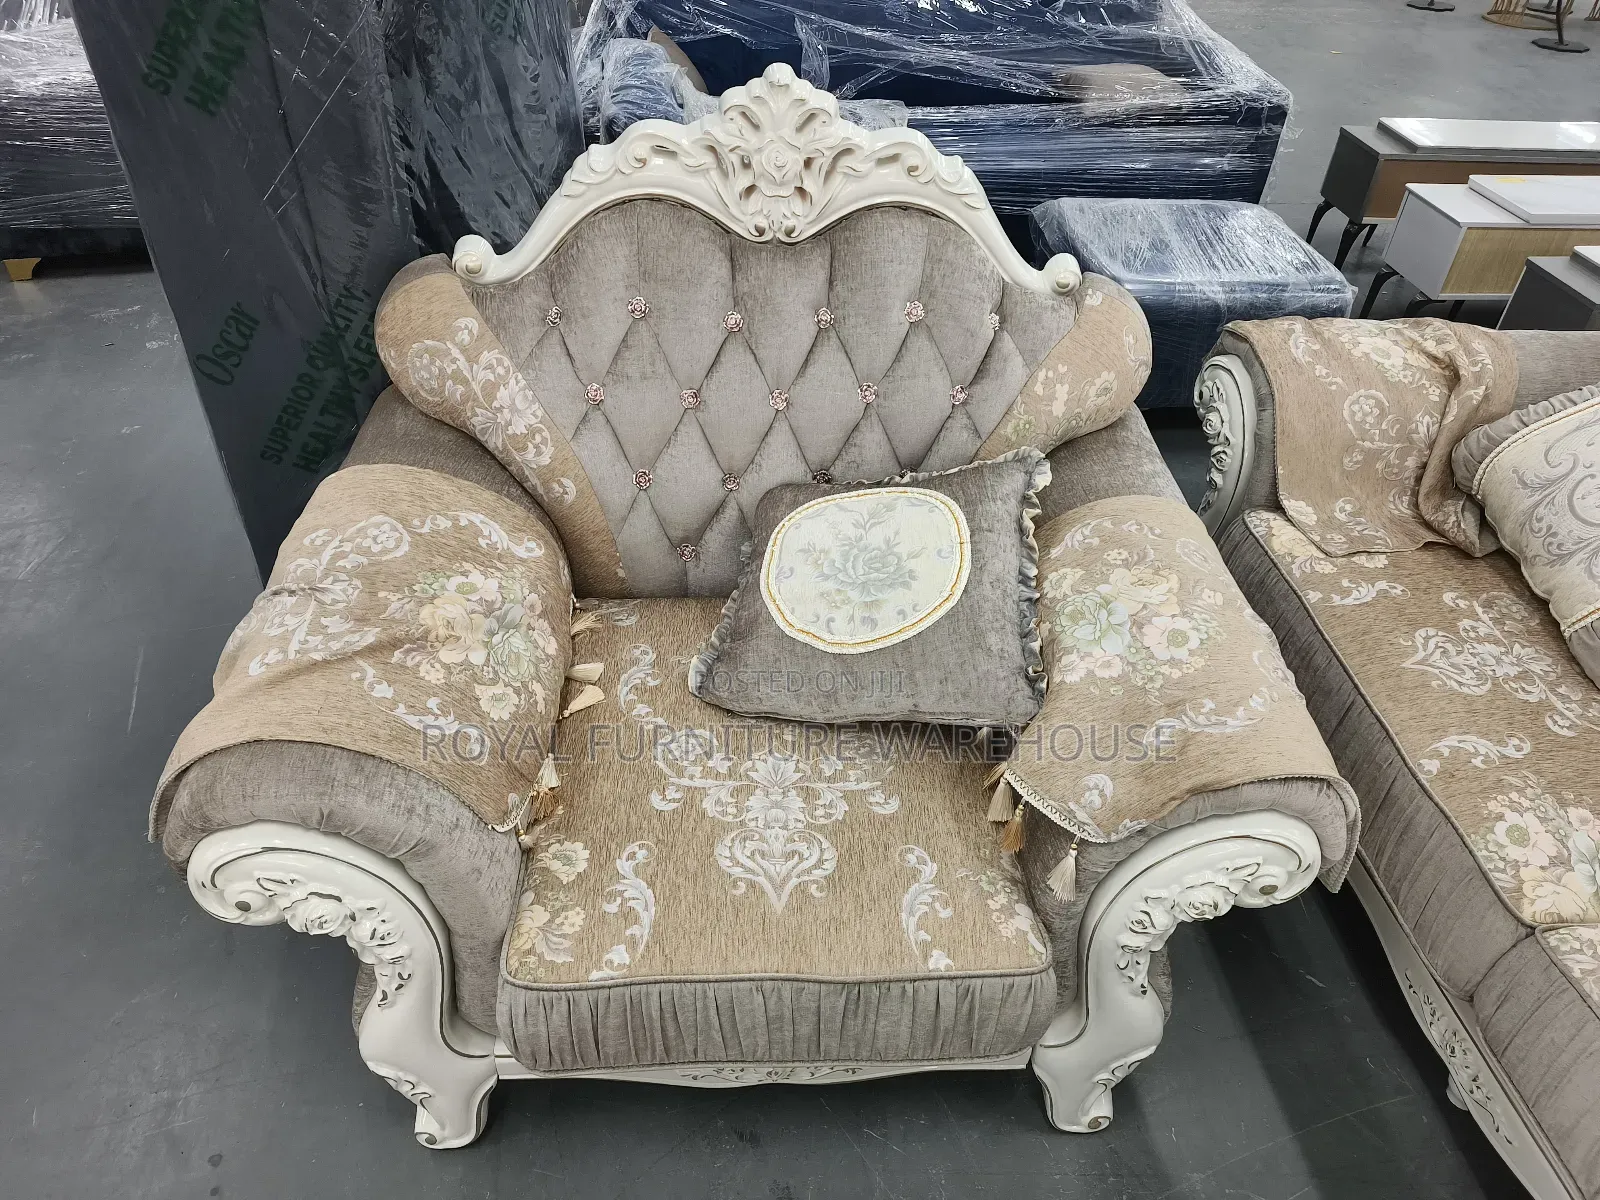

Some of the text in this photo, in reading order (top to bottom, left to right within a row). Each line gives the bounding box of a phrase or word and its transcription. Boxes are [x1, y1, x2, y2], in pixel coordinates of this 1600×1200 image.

[193, 301, 261, 386] Oscar
[260, 372, 323, 465] SUPERIOR
[292, 376, 361, 474] HEALTHY
